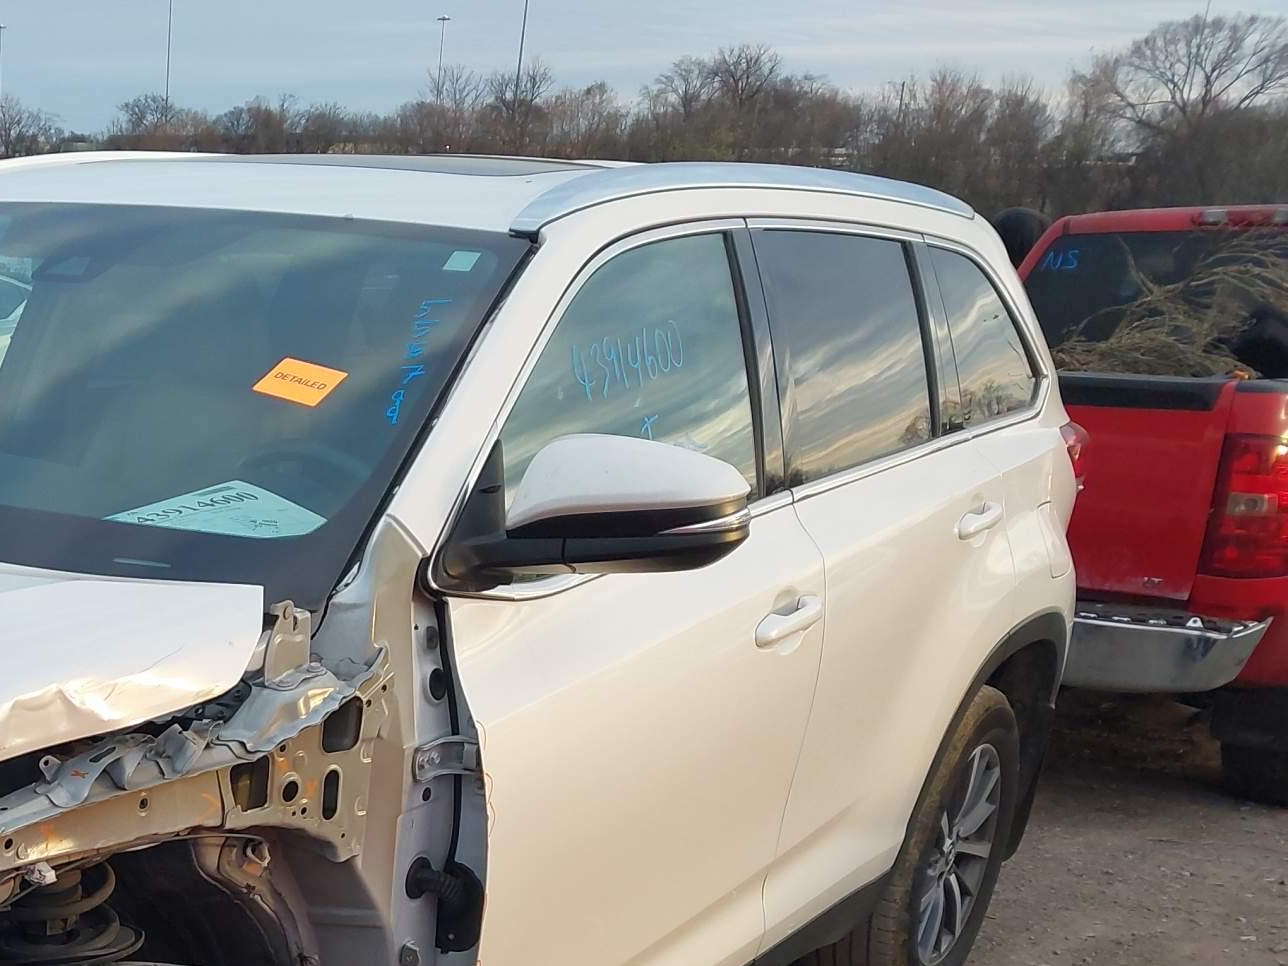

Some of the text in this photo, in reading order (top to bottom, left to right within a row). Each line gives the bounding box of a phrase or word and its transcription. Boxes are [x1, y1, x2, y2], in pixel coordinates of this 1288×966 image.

[571, 319, 684, 401] 43914600
[273, 371, 328, 391] DETAILED
[135, 491, 260, 525] 43914600
